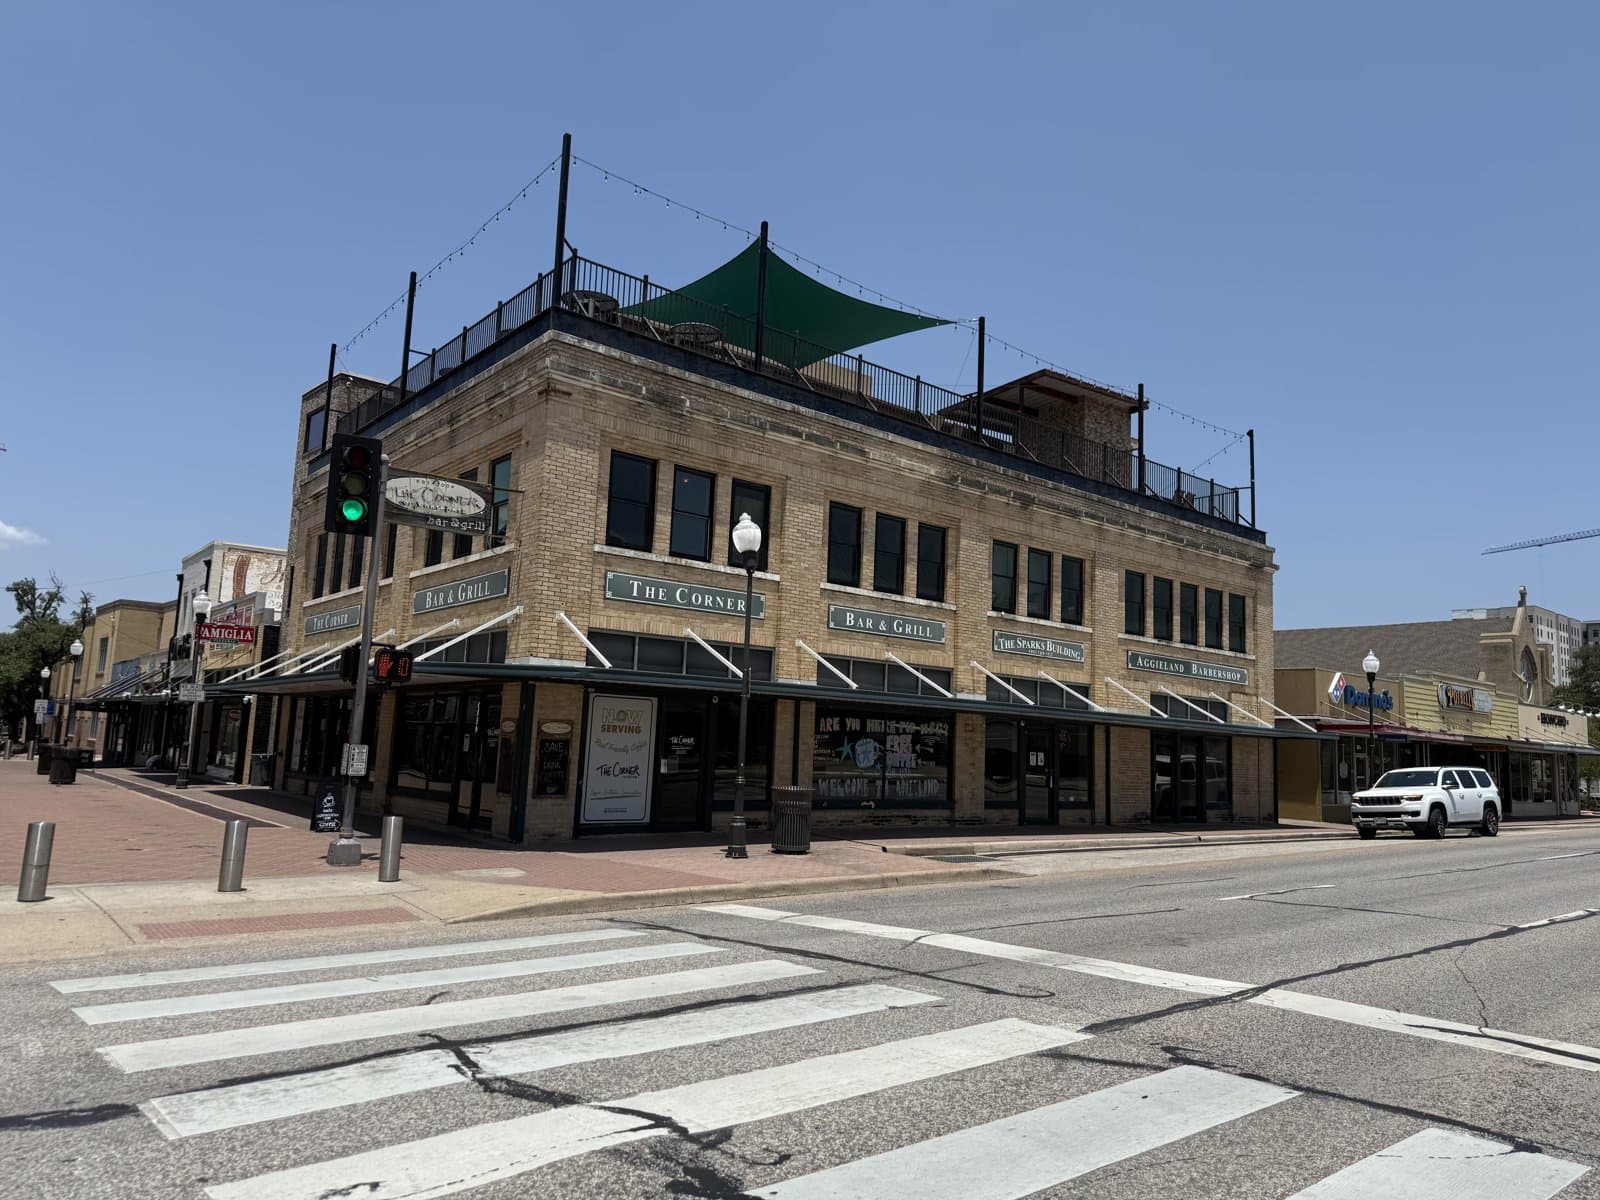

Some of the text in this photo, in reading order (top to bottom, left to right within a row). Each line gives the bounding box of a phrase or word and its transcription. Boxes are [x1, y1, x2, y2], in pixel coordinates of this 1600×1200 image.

[427, 516, 486, 531] bar & grill
[425, 580, 491, 609] BAR & GRILL
[630, 580, 746, 612] THE CORNER
[313, 613, 349, 631] THE CORNER
[846, 612, 933, 638] BAR & GRILL
[998, 638, 1016, 649] THE
[1016, 637, 1046, 650] SPARKS
[1046, 640, 1081, 661] BUILDING
[1137, 656, 1241, 681] AGGIELAND BARBERSHOP
[601, 707, 643, 724] NOW
[819, 717, 841, 732] ARE
[844, 717, 861, 732] YOU
[600, 724, 642, 734] SERVING
[596, 761, 641, 778] THE CORNER
